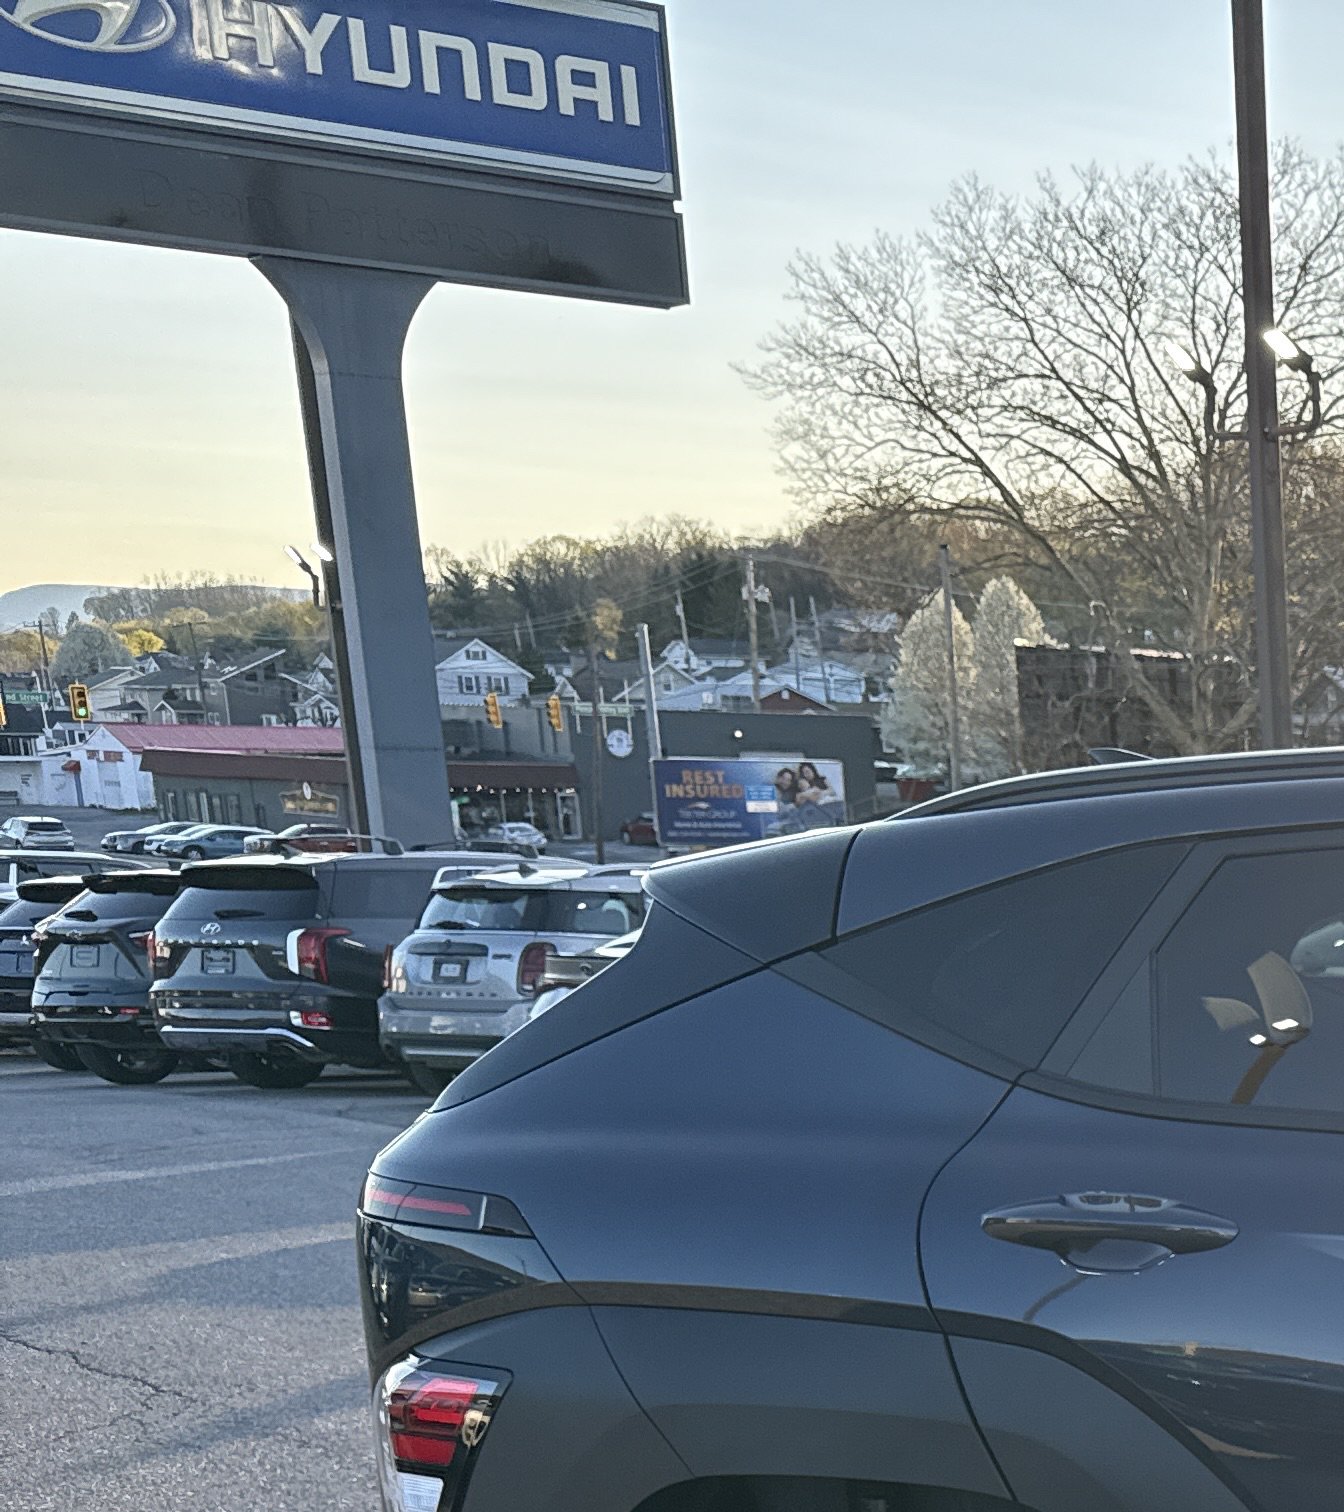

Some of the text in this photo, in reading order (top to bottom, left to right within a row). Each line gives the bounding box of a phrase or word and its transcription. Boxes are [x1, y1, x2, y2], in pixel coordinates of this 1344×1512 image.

[208, 0, 641, 127] HYUNDAI
[681, 769, 725, 784] REST
[664, 783, 744, 799] INSURED
